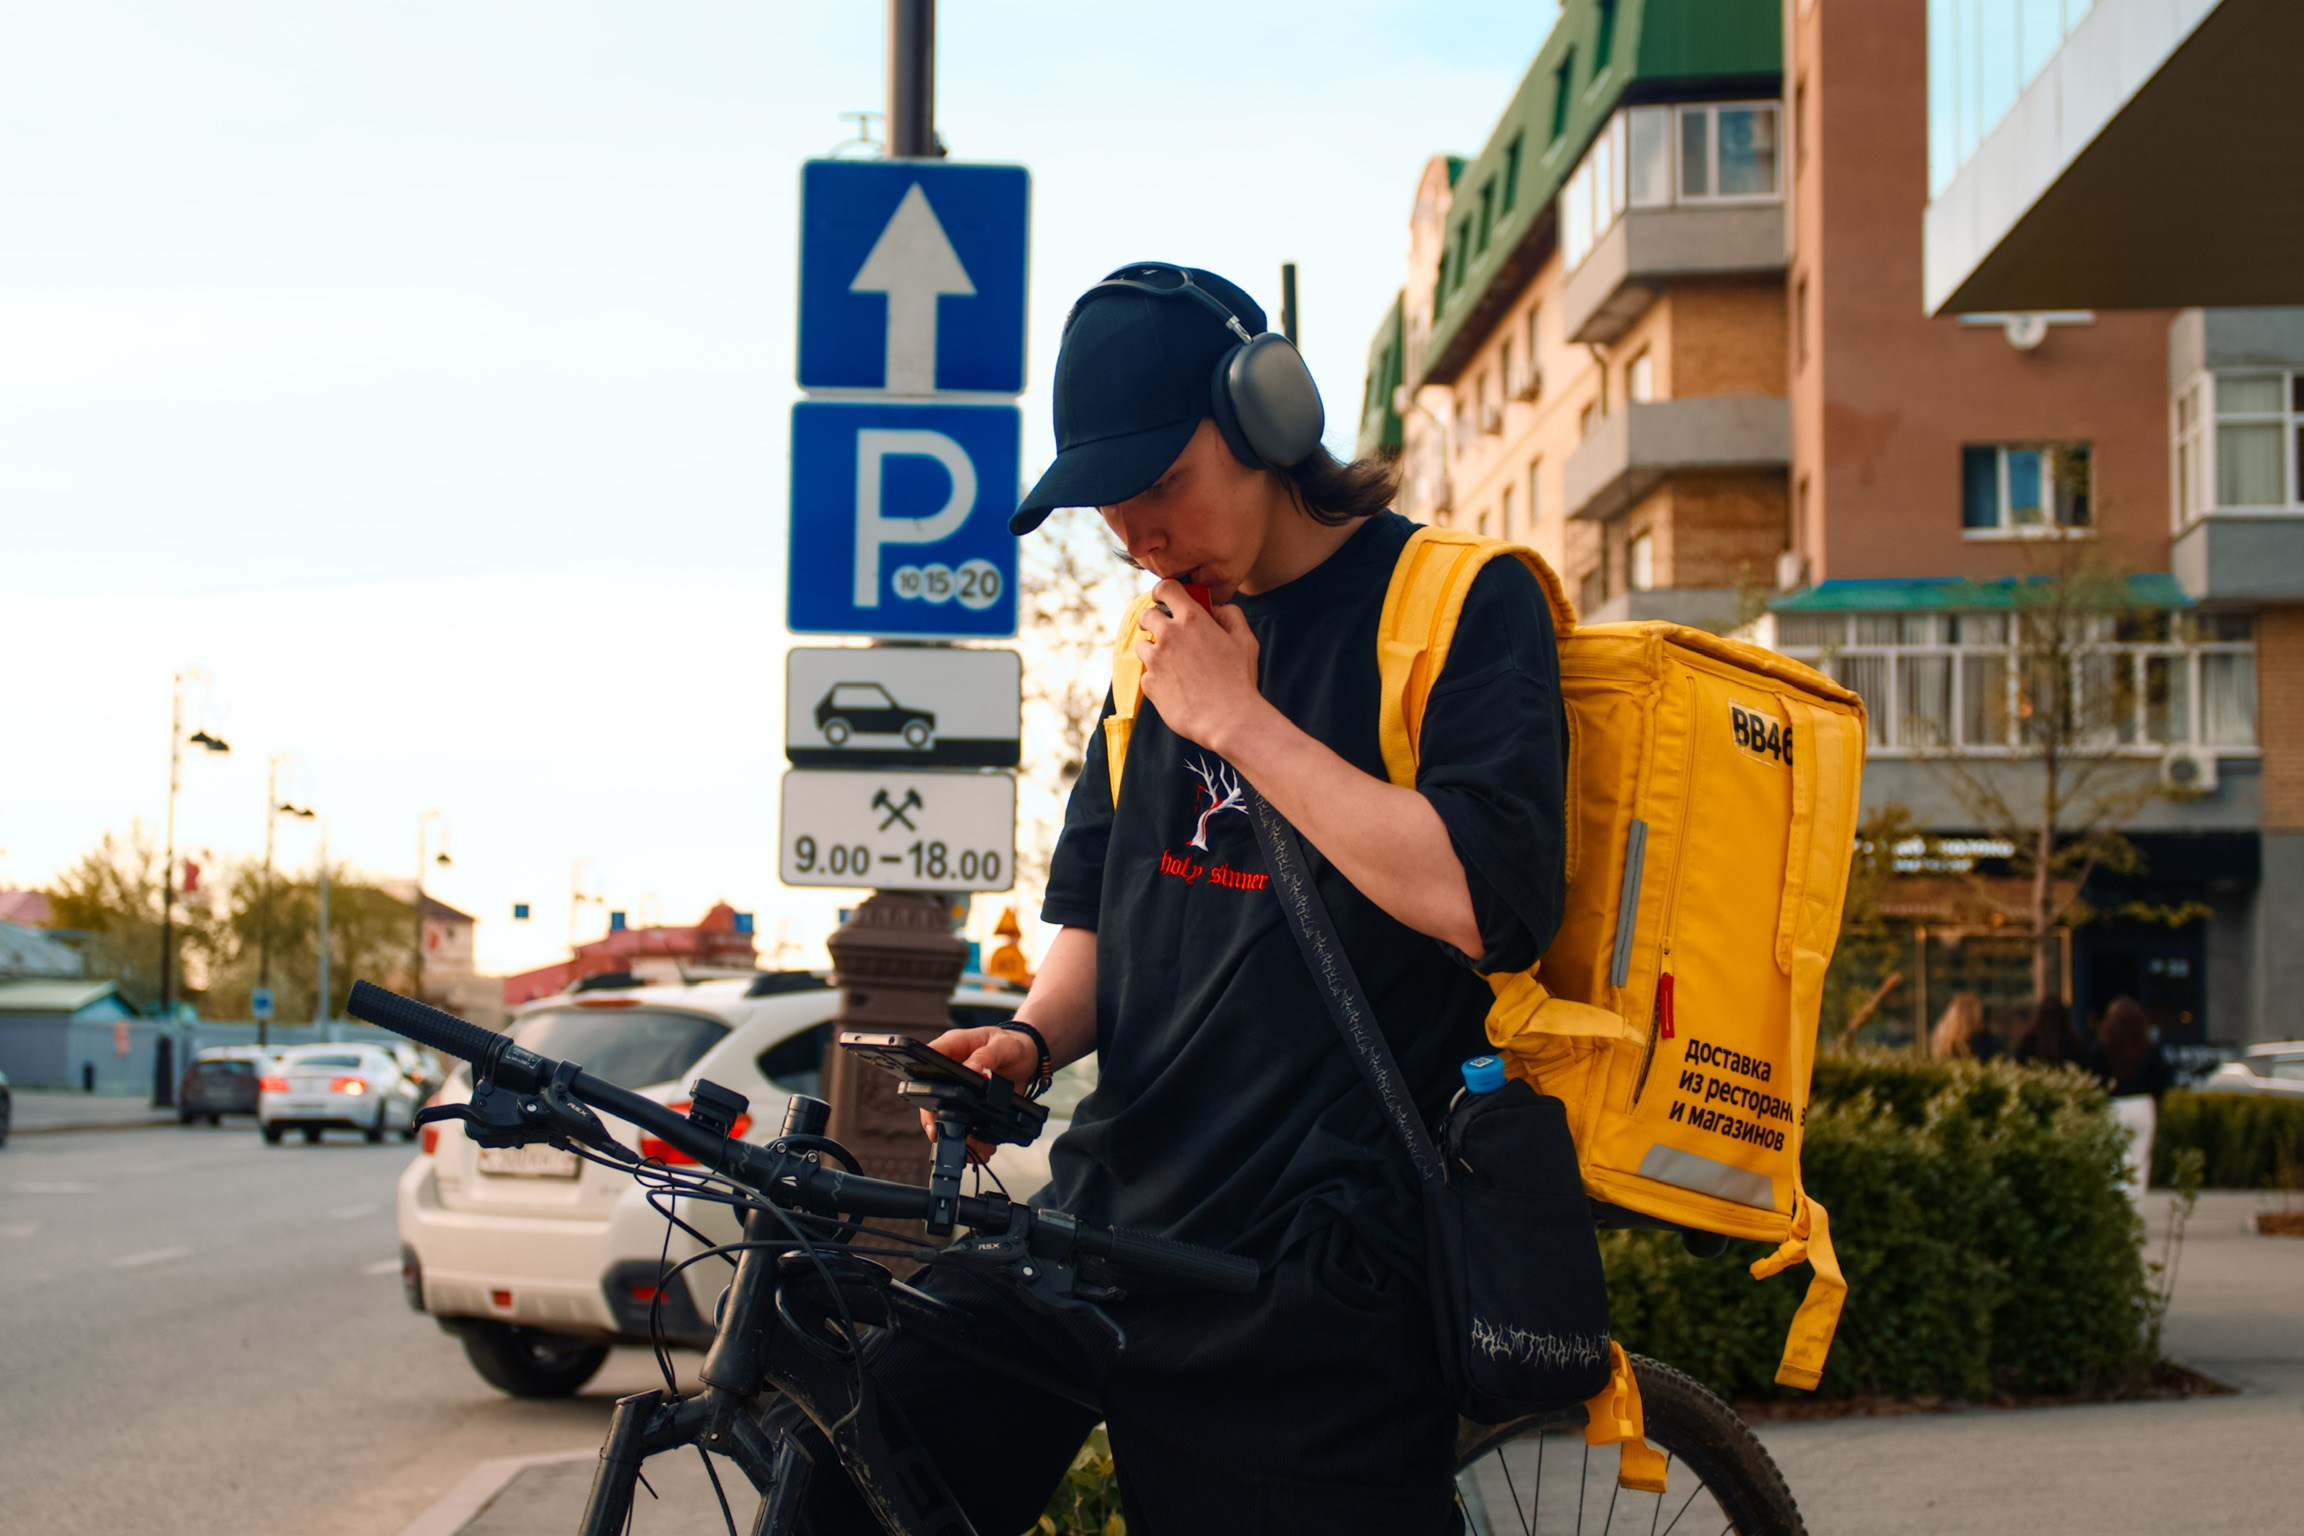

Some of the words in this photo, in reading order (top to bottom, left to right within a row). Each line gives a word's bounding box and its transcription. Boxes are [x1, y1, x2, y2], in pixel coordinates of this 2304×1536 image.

[854, 428, 977, 608] P
[900, 573, 921, 591] 10
[925, 570, 950, 594] 15
[957, 568, 999, 598] 20
[1160, 849, 1204, 885] holy
[1207, 863, 1270, 892] sinner
[1684, 1038, 1772, 1082] доставка
[1678, 1069, 1704, 1095] из
[1668, 1100, 1686, 1123] и
[1687, 1105, 1785, 1152] магазинов
